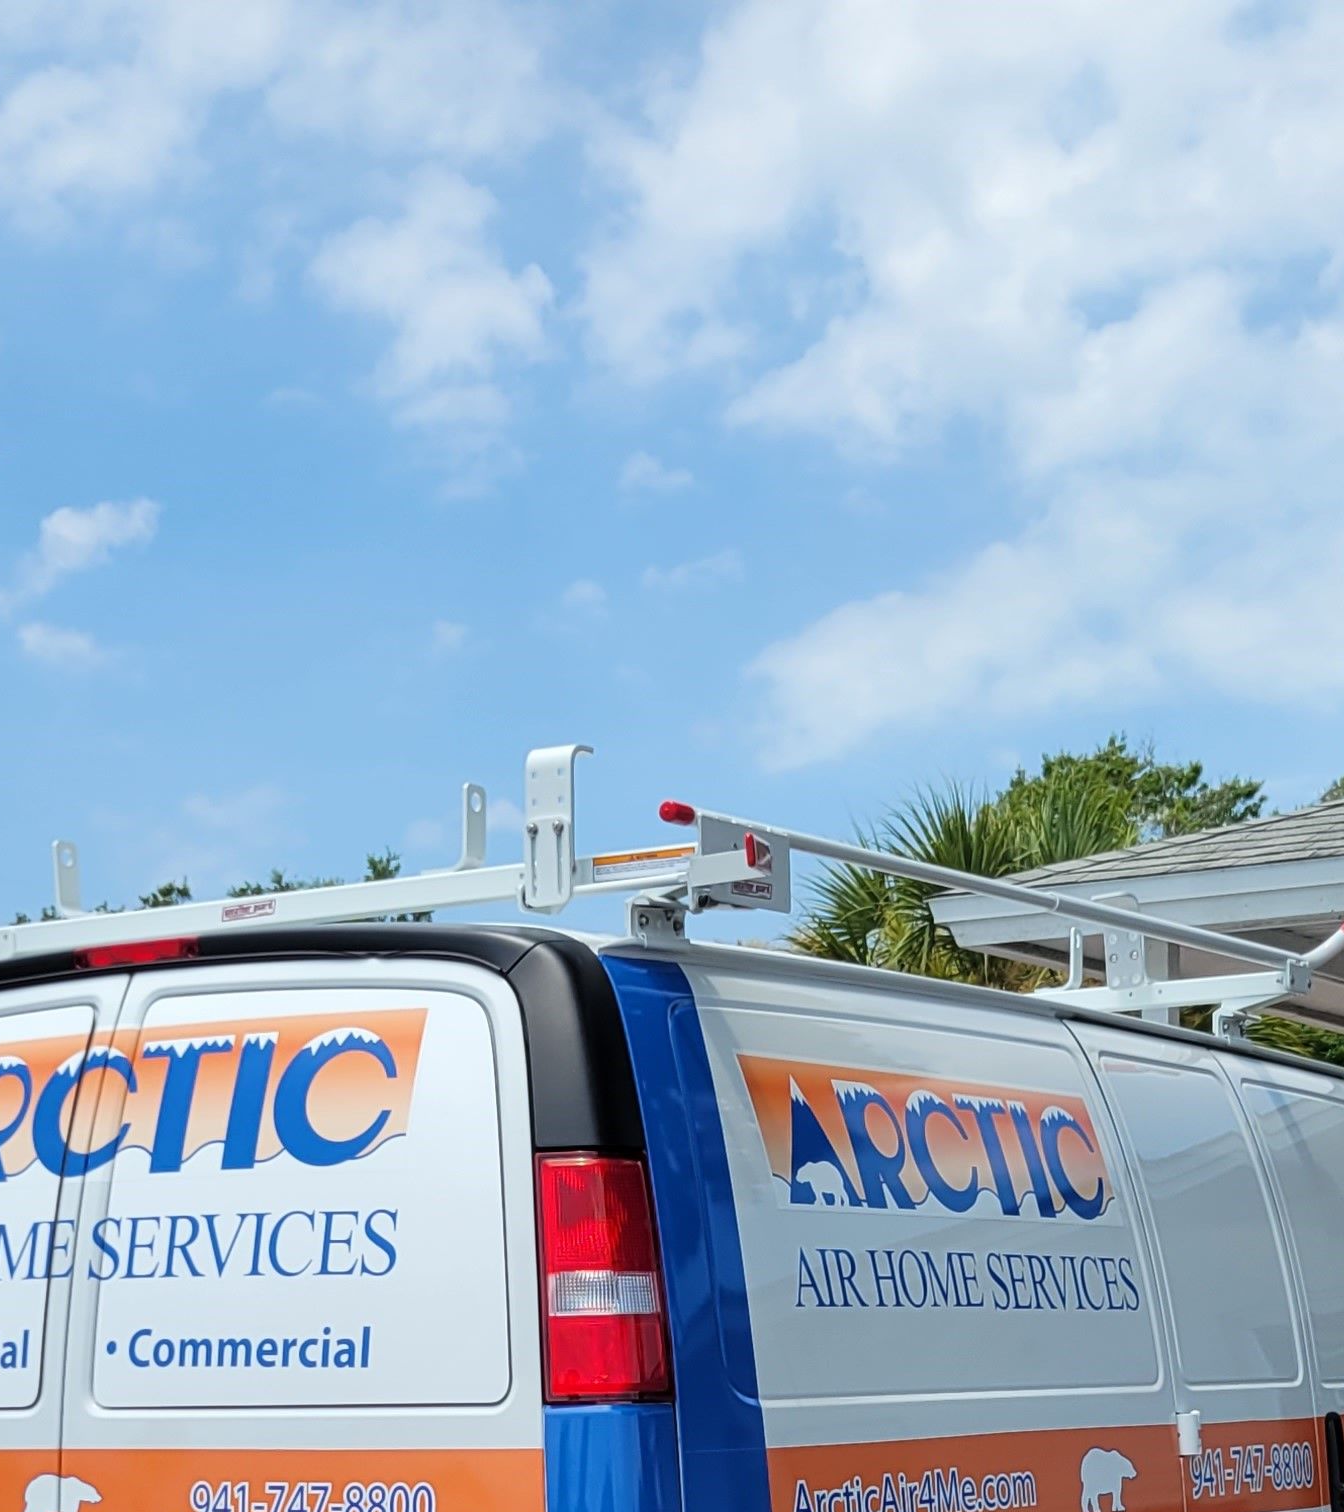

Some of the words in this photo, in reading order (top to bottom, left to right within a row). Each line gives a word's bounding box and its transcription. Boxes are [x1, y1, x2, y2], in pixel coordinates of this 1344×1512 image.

[790, 1074, 1104, 1221] ARCTIC
[87, 1209, 399, 1281] SERVICES
[795, 1247, 869, 1309] AIR
[866, 1249, 985, 1309] HOME
[986, 1252, 1140, 1312] SERVICES
[129, 1326, 371, 1370] Commercial
[1190, 1441, 1314, 1500] 941-747-8800
